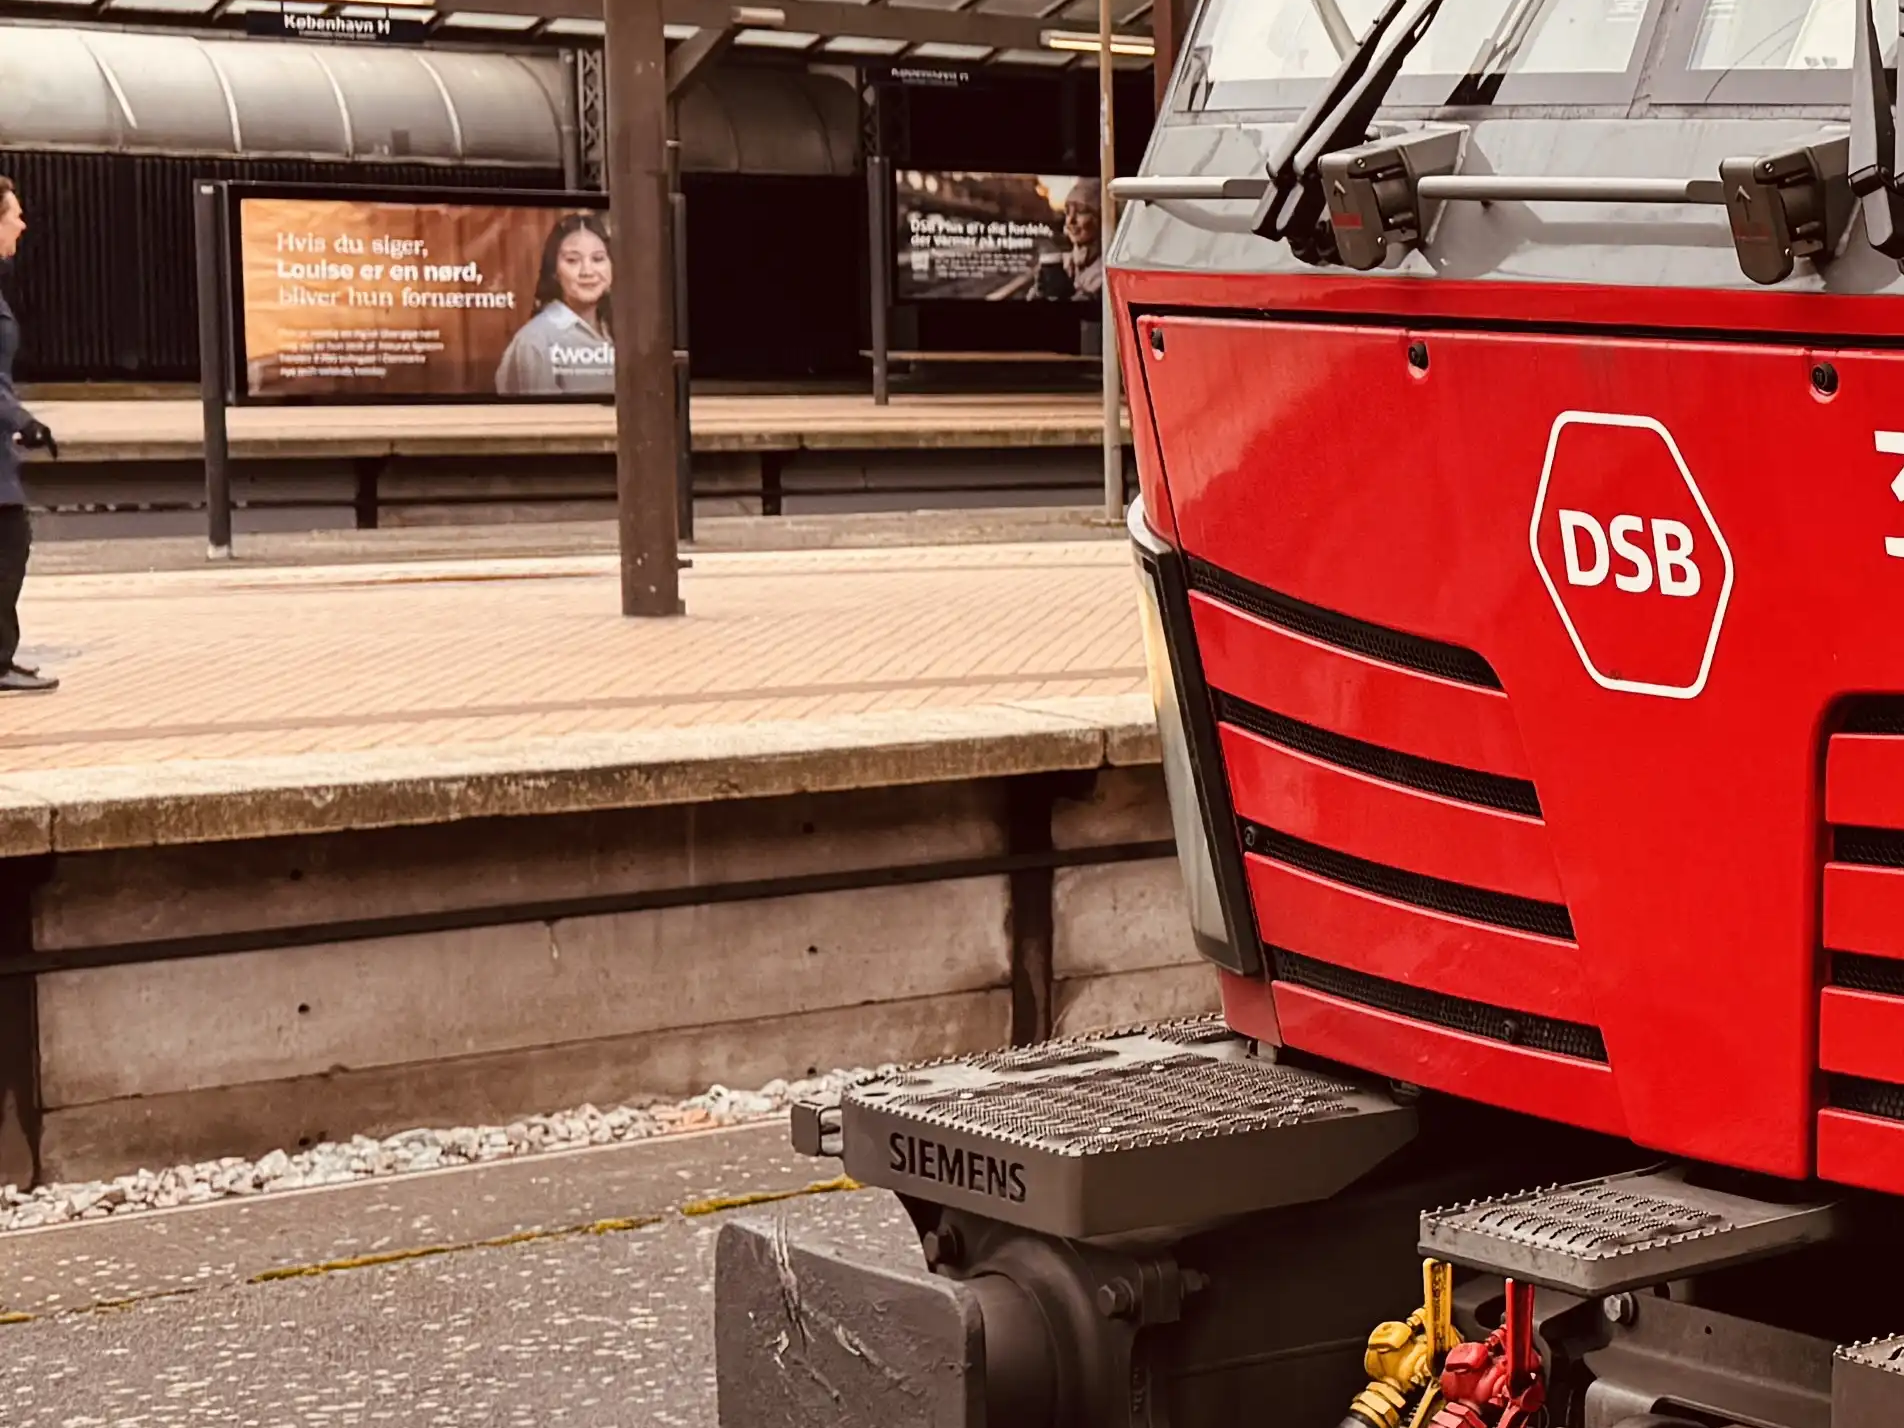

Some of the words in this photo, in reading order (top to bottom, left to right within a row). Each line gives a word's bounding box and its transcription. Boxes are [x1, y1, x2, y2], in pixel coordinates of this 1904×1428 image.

[284, 13, 374, 32] København
[377, 19, 391, 35] H
[276, 232, 325, 253] Hvis
[334, 233, 363, 254] du
[372, 234, 429, 259] siger,
[276, 258, 352, 280] Louise
[359, 263, 384, 281] er
[390, 264, 418, 282] en
[423, 260, 483, 285] nørd,
[279, 286, 340, 306] bliver
[348, 286, 394, 307] hun
[401, 287, 515, 310] fornærmet
[1559, 510, 1700, 596] DSB
[890, 1132, 1026, 1202] SIEMENS
